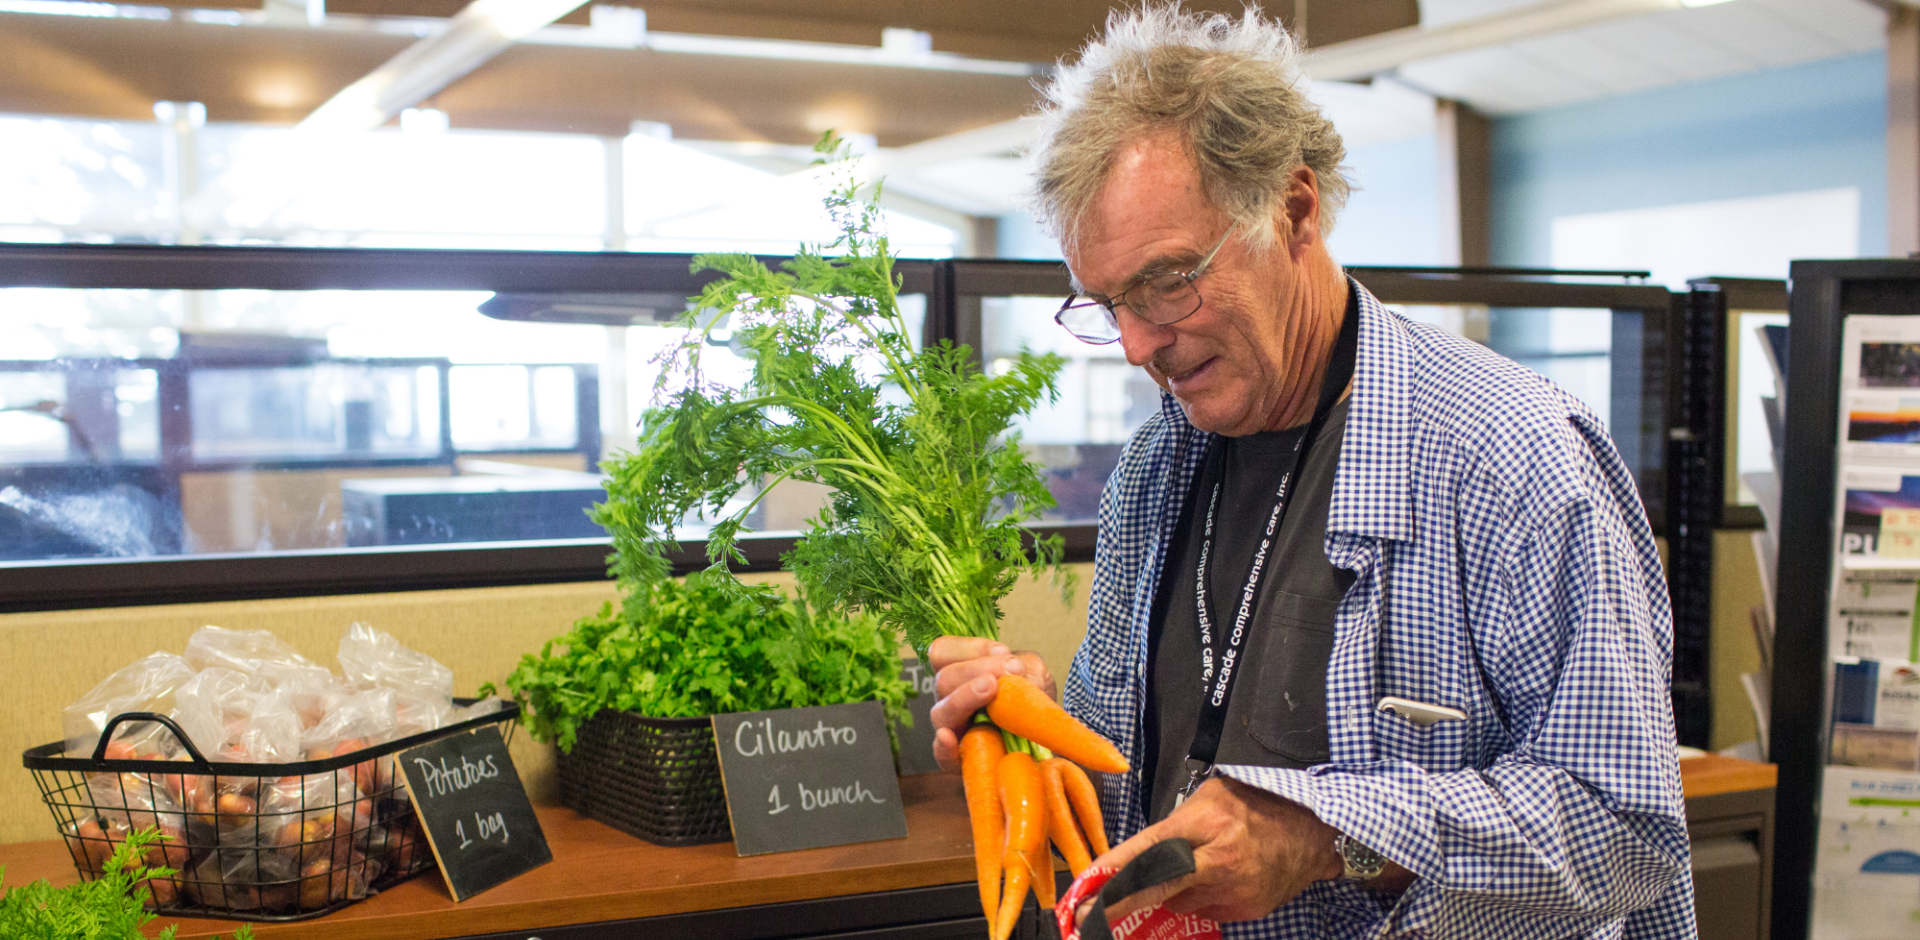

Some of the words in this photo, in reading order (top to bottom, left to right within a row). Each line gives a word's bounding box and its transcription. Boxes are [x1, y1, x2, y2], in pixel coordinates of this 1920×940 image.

[1204, 482, 1219, 536] cascade
[1196, 539, 1212, 644] comprehensive
[1211, 649, 1236, 707] cascade
[1230, 539, 1270, 647] comprehensive
[1266, 501, 1284, 536] care,
[1276, 472, 1290, 498] inc.
[734, 718, 858, 758] Cilantro
[414, 753, 500, 799] Potatoes
[767, 789, 790, 815] 1
[800, 780, 886, 811] bunch
[455, 819, 474, 850] 1
[476, 808, 511, 844] bag
